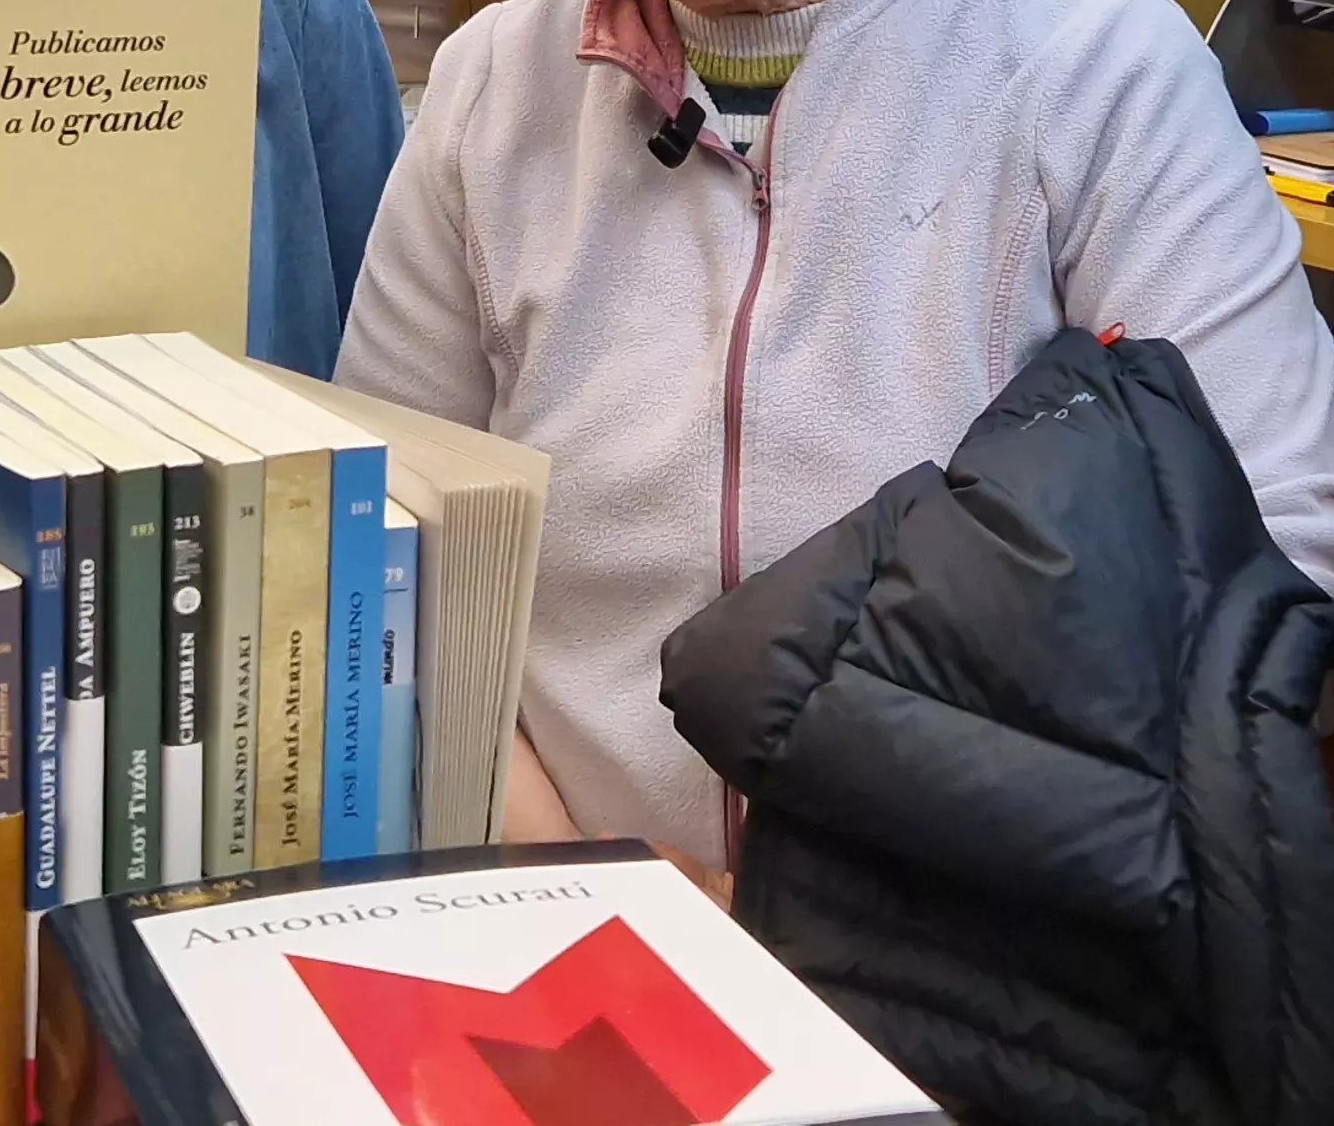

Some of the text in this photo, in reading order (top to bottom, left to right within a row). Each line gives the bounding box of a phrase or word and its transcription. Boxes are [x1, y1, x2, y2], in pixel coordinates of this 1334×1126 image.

[0, 64, 114, 104] breve,
[119, 70, 209, 94] leemos
[9, 29, 167, 57] Publicamos
[4, 99, 185, 147] a lo grande
[74, 558, 96, 668] AMPUERO
[229, 633, 252, 856] FERNANDO IWASAKI
[280, 629, 304, 848] JOSÉ MARÍA MERINO
[341, 590, 365, 820] JOSÉ MARÍA MERINO
[36, 665, 58, 890] GUADALUPE NETTEL
[126, 748, 149, 882] ELOY TIZÓN
[181, 879, 595, 951] Antonio Scurati
